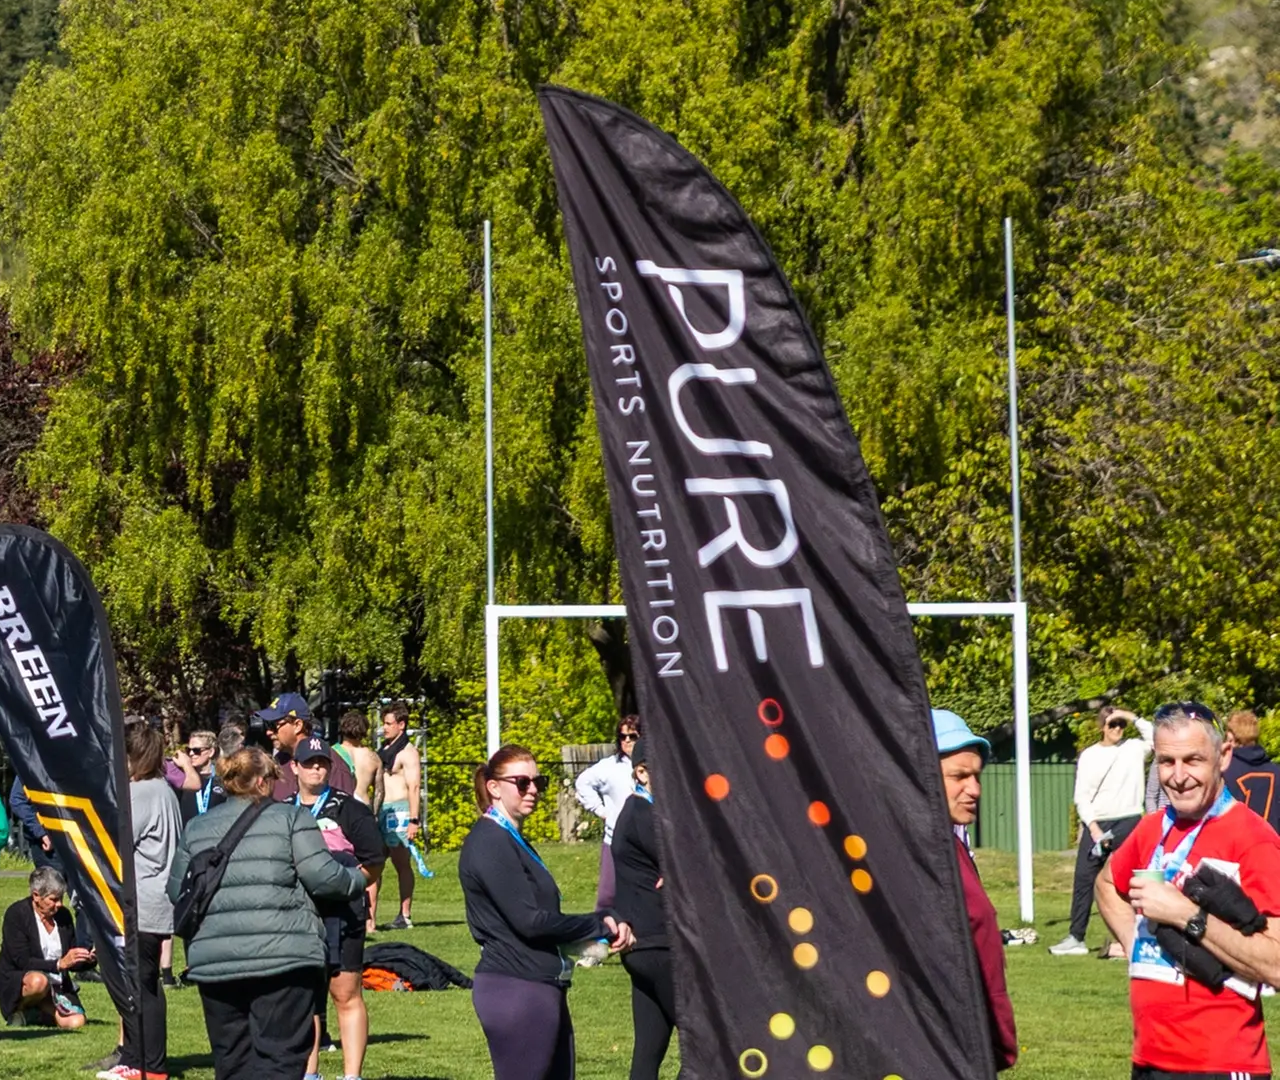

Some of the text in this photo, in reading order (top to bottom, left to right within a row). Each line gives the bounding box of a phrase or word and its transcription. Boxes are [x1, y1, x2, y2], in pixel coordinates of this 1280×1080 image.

[595, 256, 684, 678] SPORTS NUTRITION
[635, 260, 824, 673] PURE
